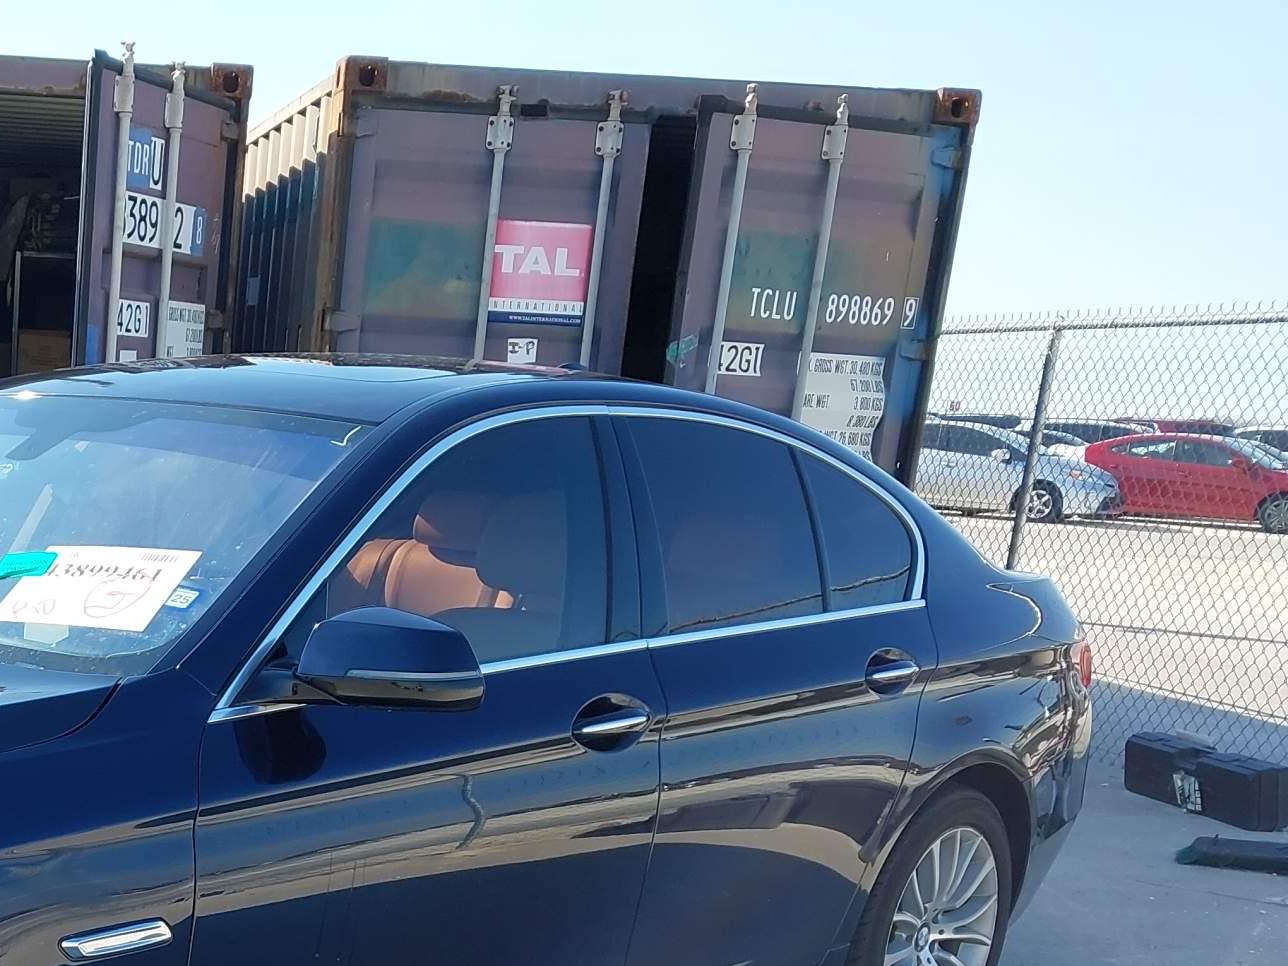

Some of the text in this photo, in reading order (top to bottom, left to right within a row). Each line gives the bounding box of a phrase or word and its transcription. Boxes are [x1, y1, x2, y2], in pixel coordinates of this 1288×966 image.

[494, 244, 580, 277] TAL
[493, 300, 582, 312] NTERNATIONAL
[750, 287, 917, 327] TCLU 898869 9
[814, 358, 832, 373] GROSS
[170, 593, 191, 605] 25
